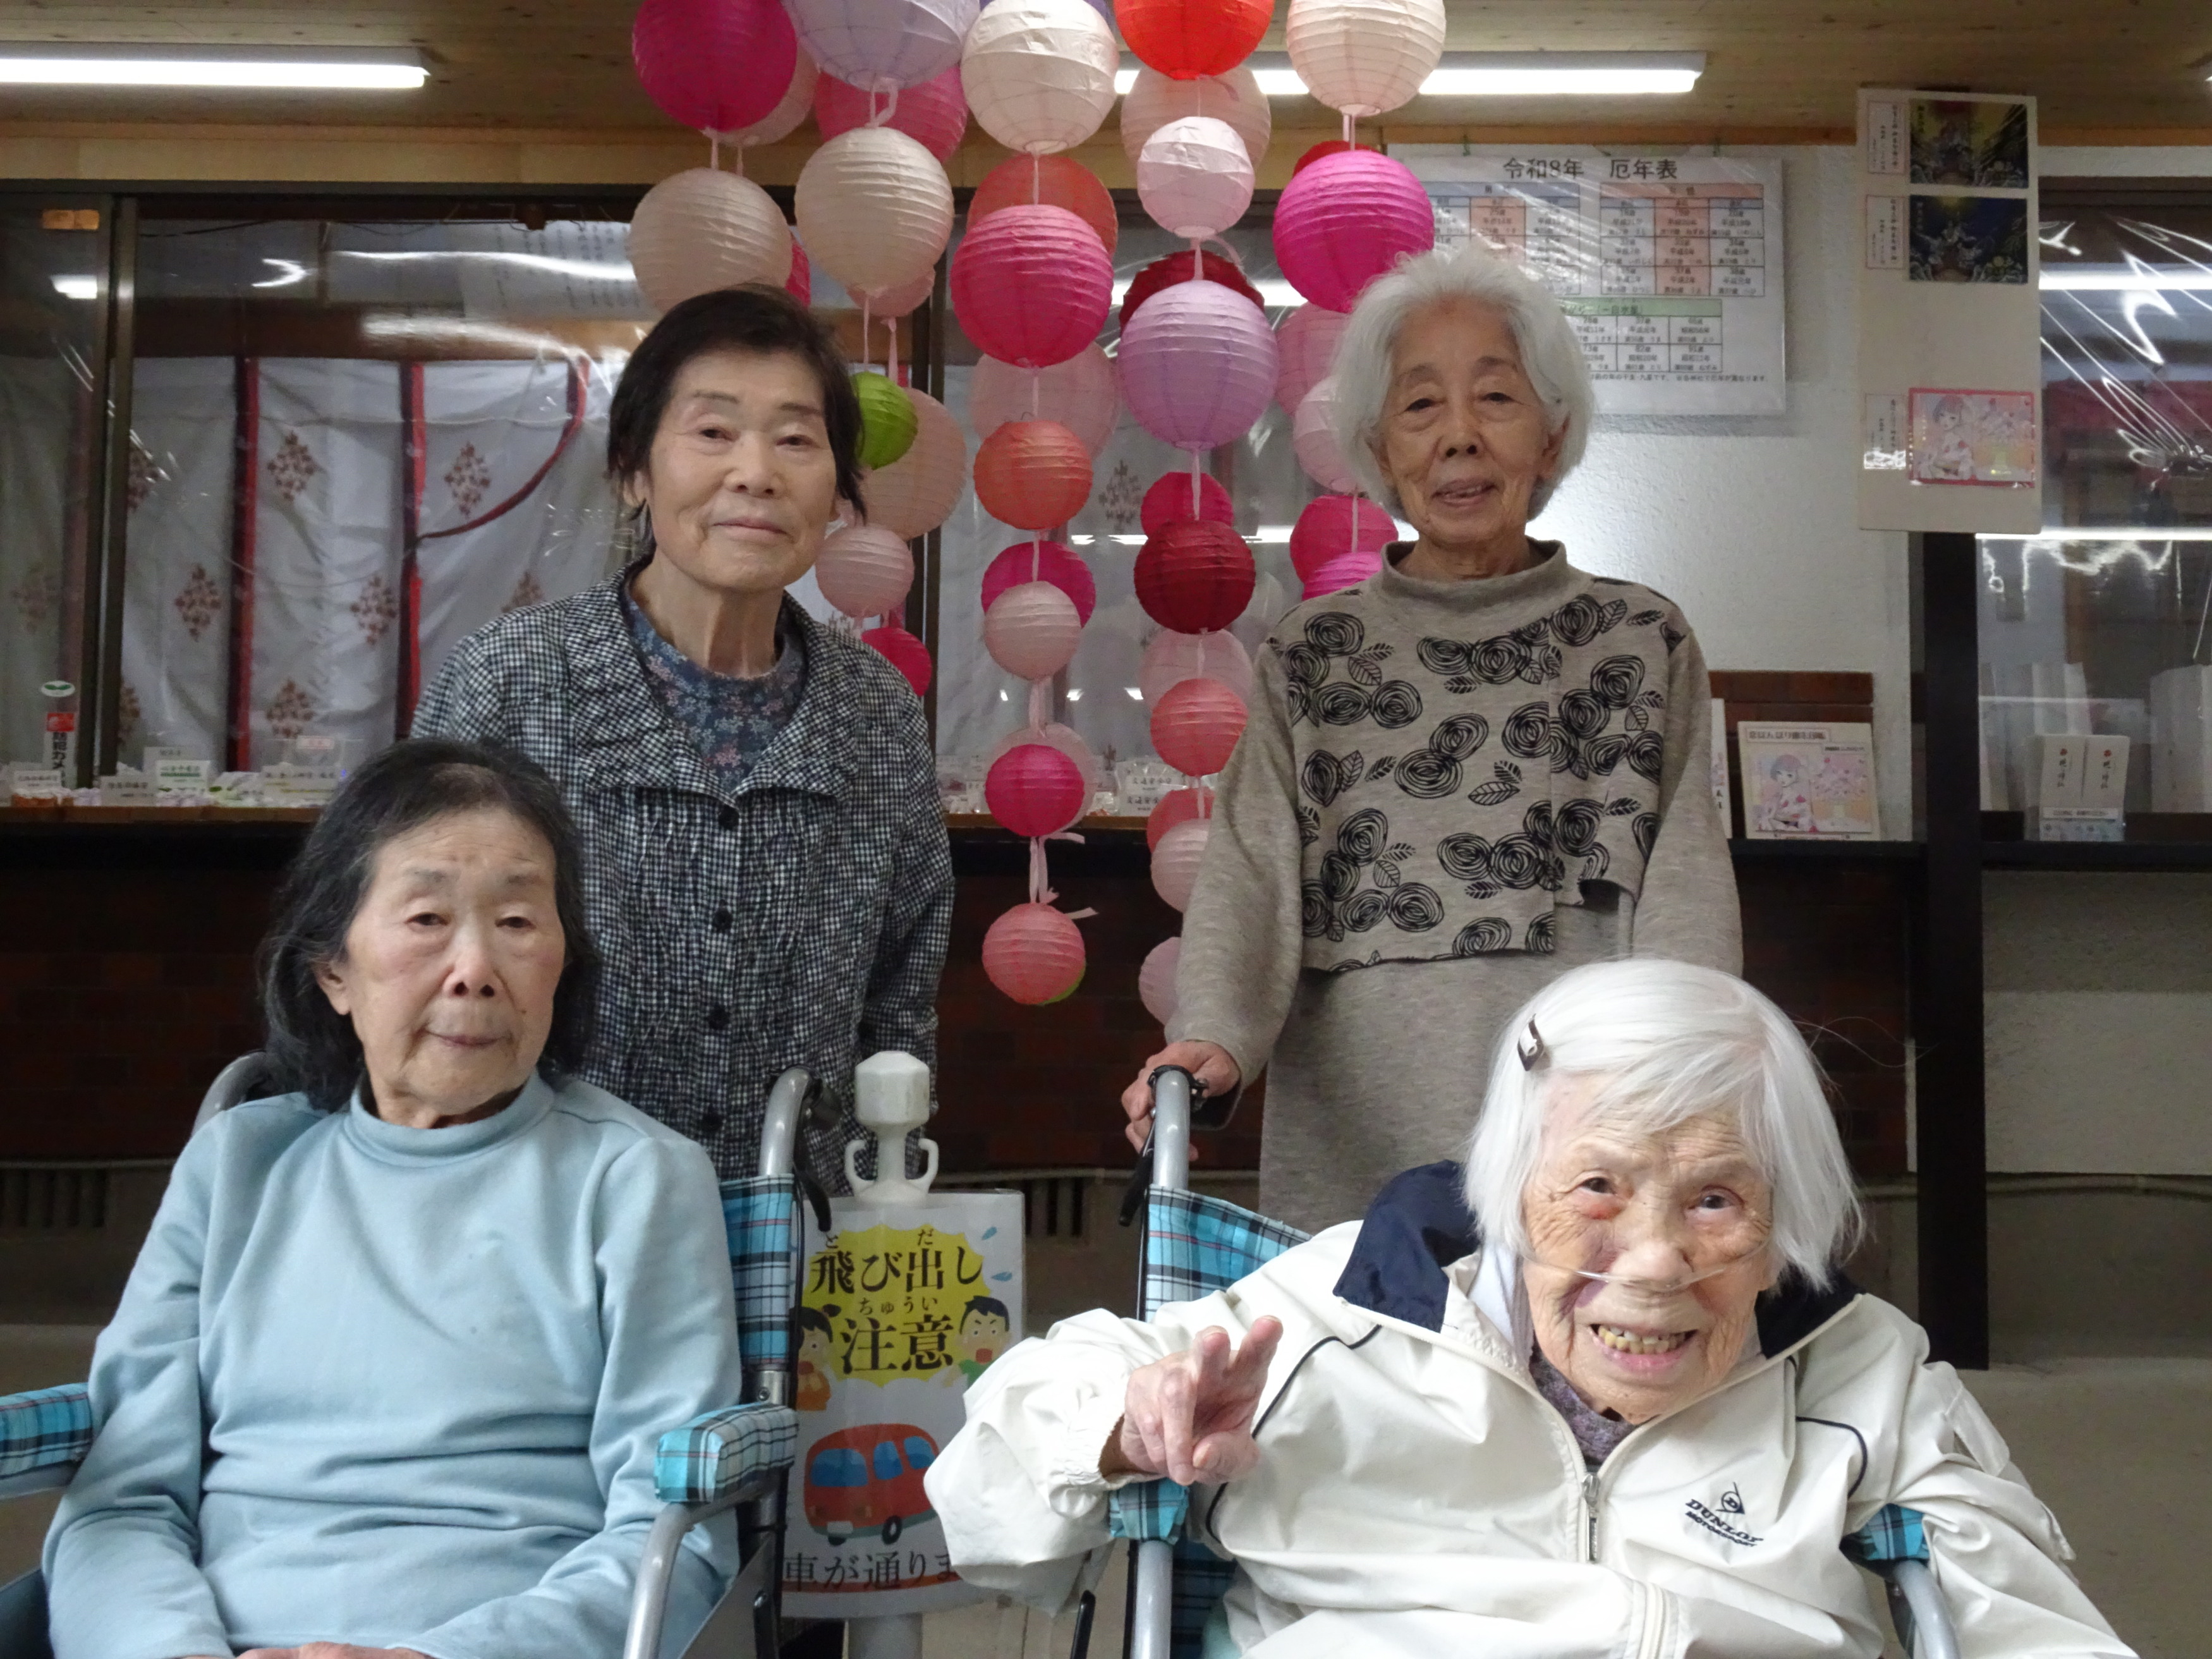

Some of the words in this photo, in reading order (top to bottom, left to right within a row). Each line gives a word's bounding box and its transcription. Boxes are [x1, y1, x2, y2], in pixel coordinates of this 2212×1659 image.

[1504, 157, 1584, 179] 令和8年
[1610, 158, 1678, 180] 厄年表
[825, 1234, 839, 1249] と
[918, 1228, 933, 1246] だ
[810, 1246, 983, 1295] 飛び出し
[860, 1297, 938, 1315] ちゅうい
[840, 1313, 954, 1375] 注意
[1685, 1498, 1764, 1543] DUNLOP
